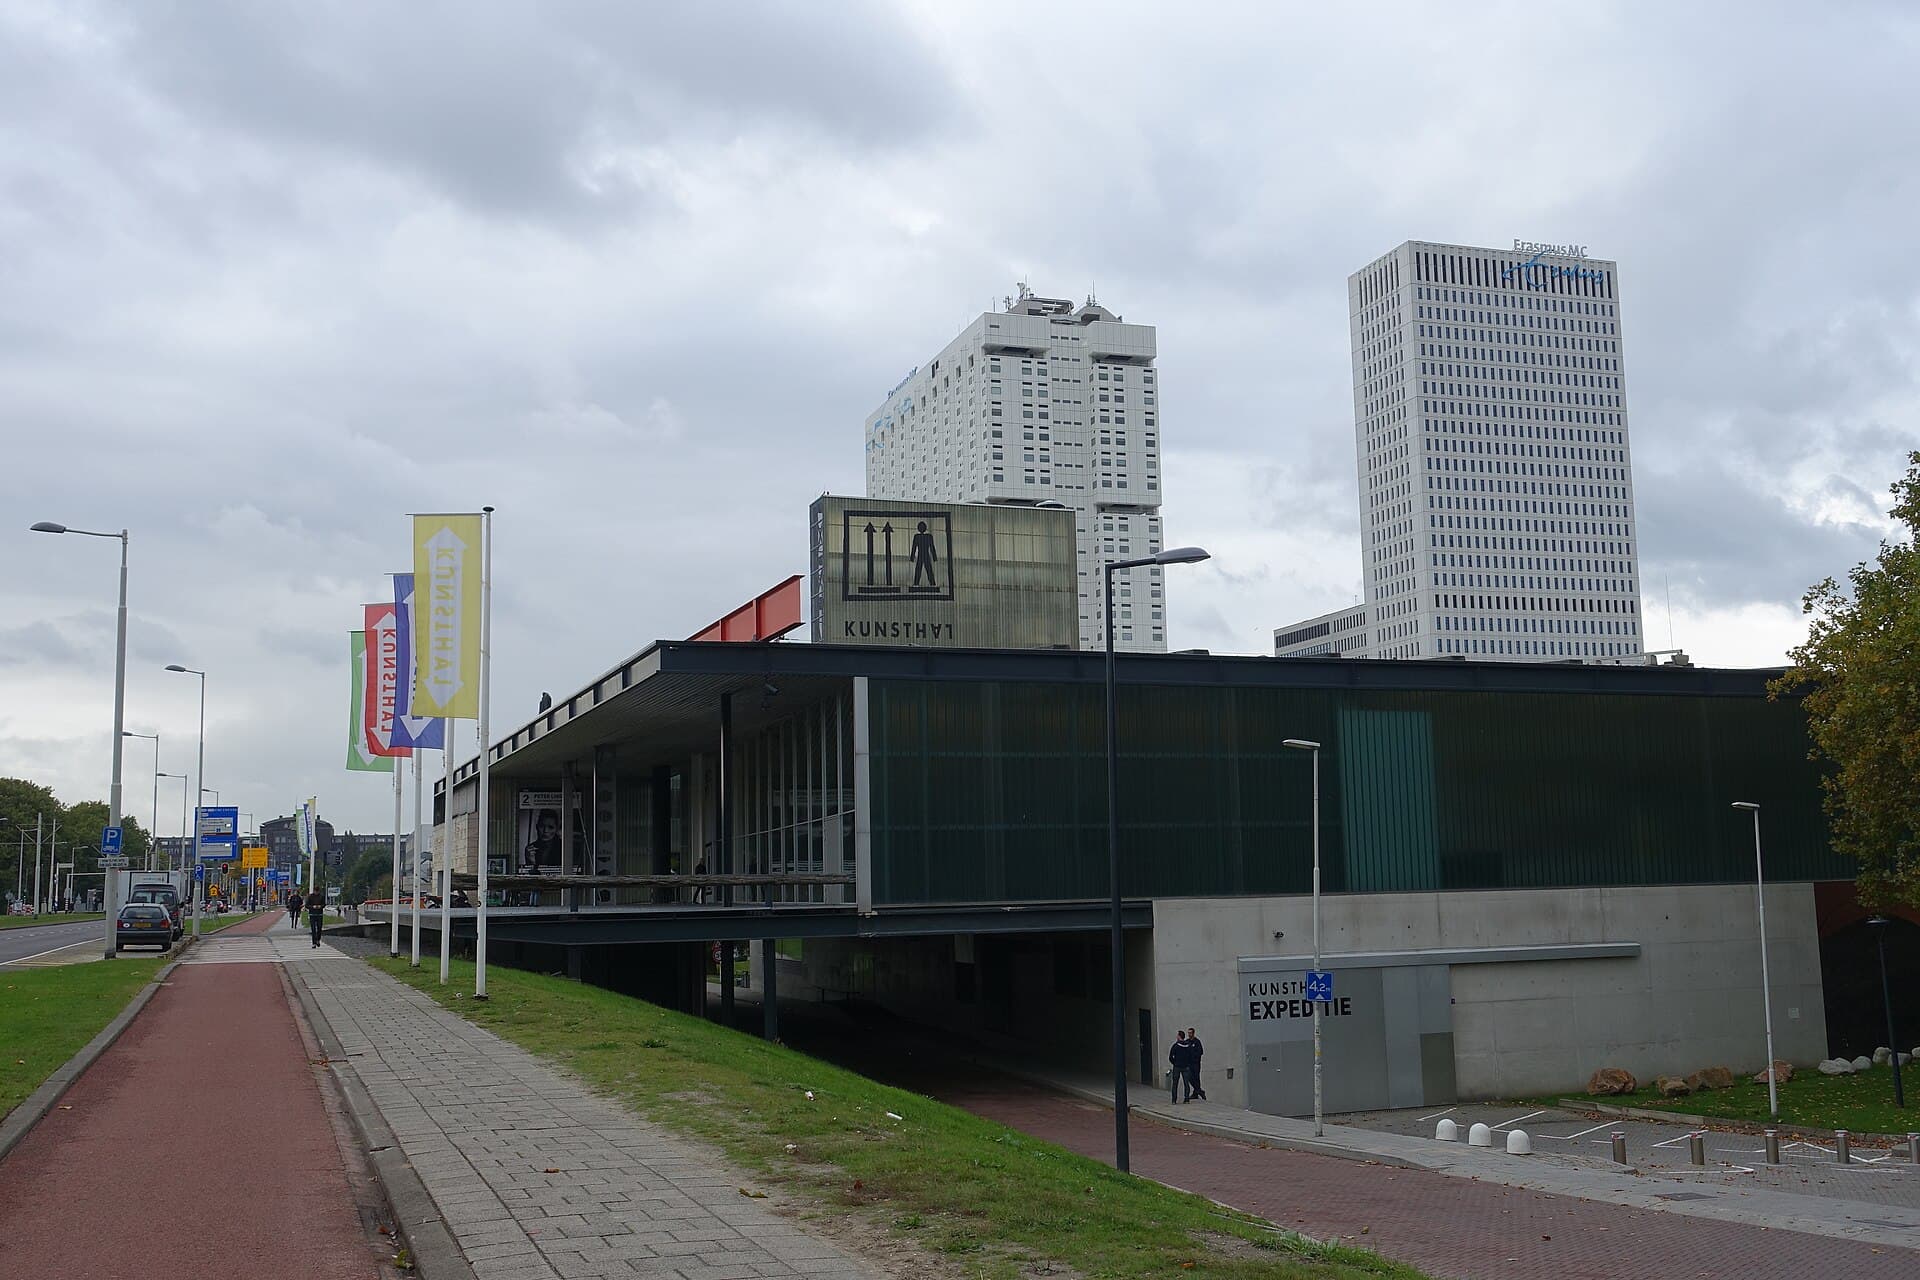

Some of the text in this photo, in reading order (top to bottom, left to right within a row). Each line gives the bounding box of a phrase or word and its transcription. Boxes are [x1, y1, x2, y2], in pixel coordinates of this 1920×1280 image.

[844, 620, 953, 640] KUNSTHAL
[522, 794, 530, 803] 2
[106, 829, 118, 843] P
[195, 865, 202, 874] P
[1249, 981, 1307, 997] KUNSTH
[1249, 997, 1352, 1020] EXPEDTIE
